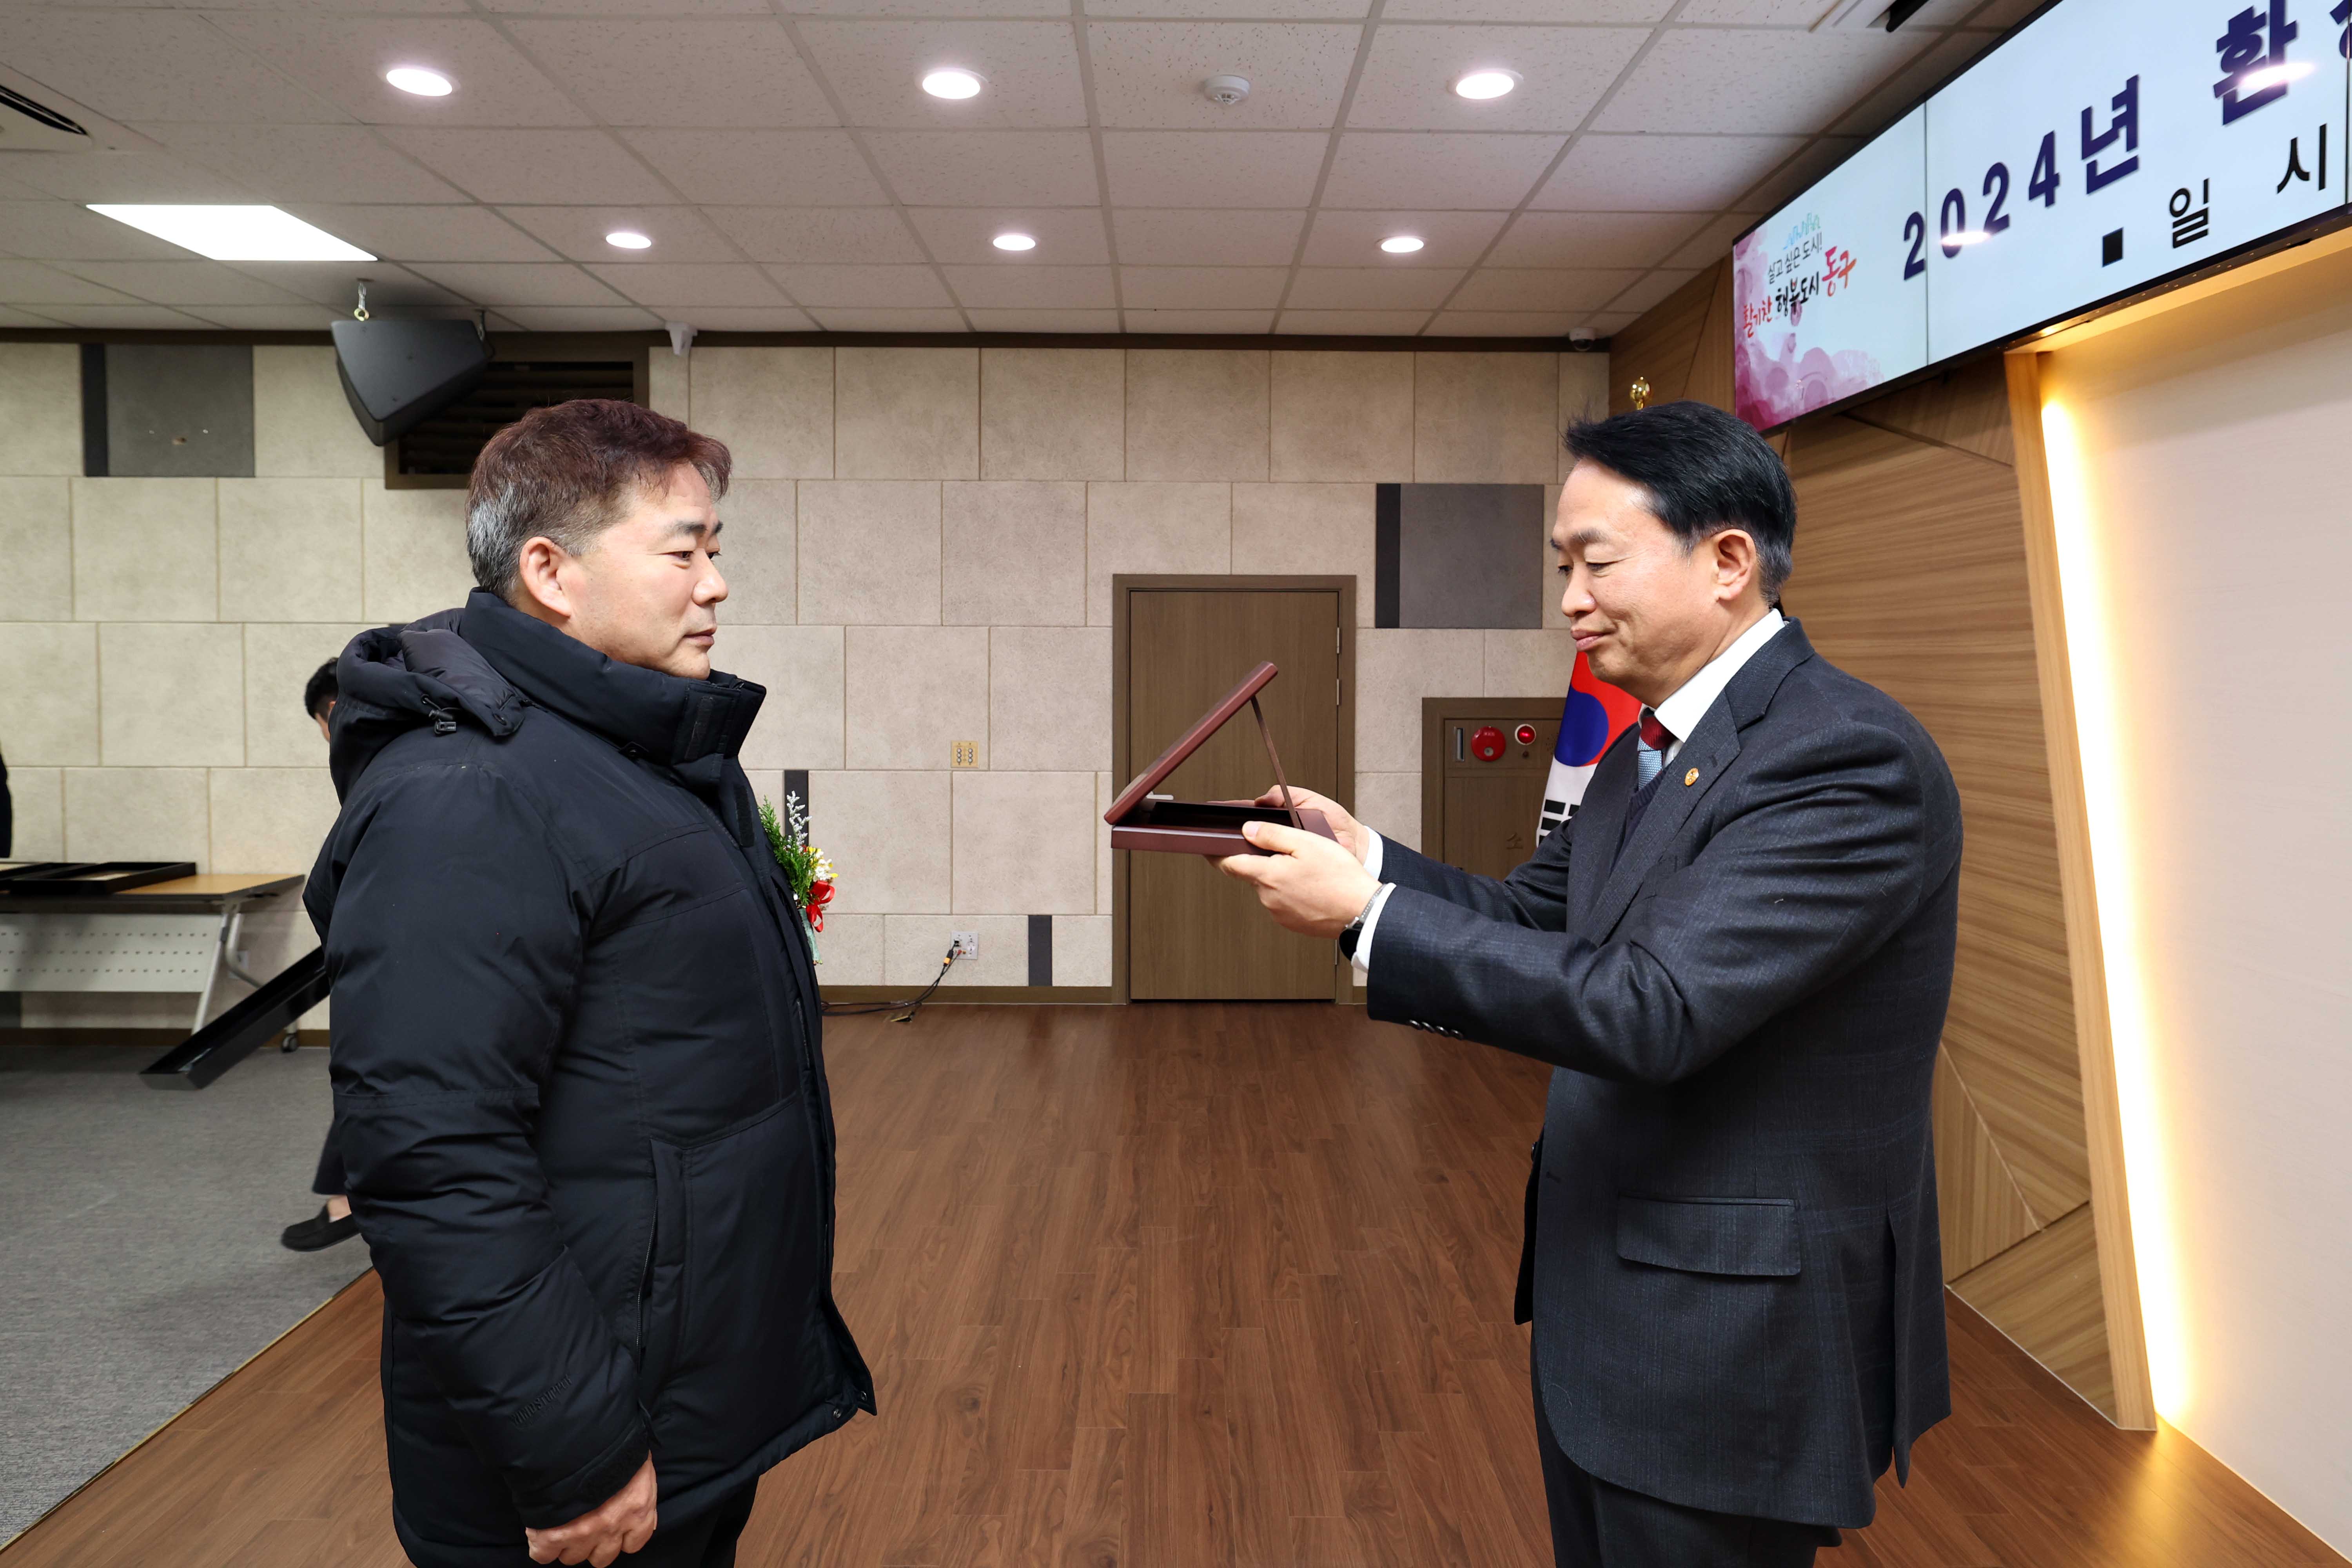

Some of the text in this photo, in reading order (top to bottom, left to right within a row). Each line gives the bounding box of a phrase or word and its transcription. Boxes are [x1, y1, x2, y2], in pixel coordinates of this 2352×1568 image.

[1904, 74, 2139, 281] 2024년
[1744, 295, 1773, 338] 활기찬
[1822, 245, 1857, 297] 동구
[1768, 232, 1822, 285] 살고 싶은 도시!
